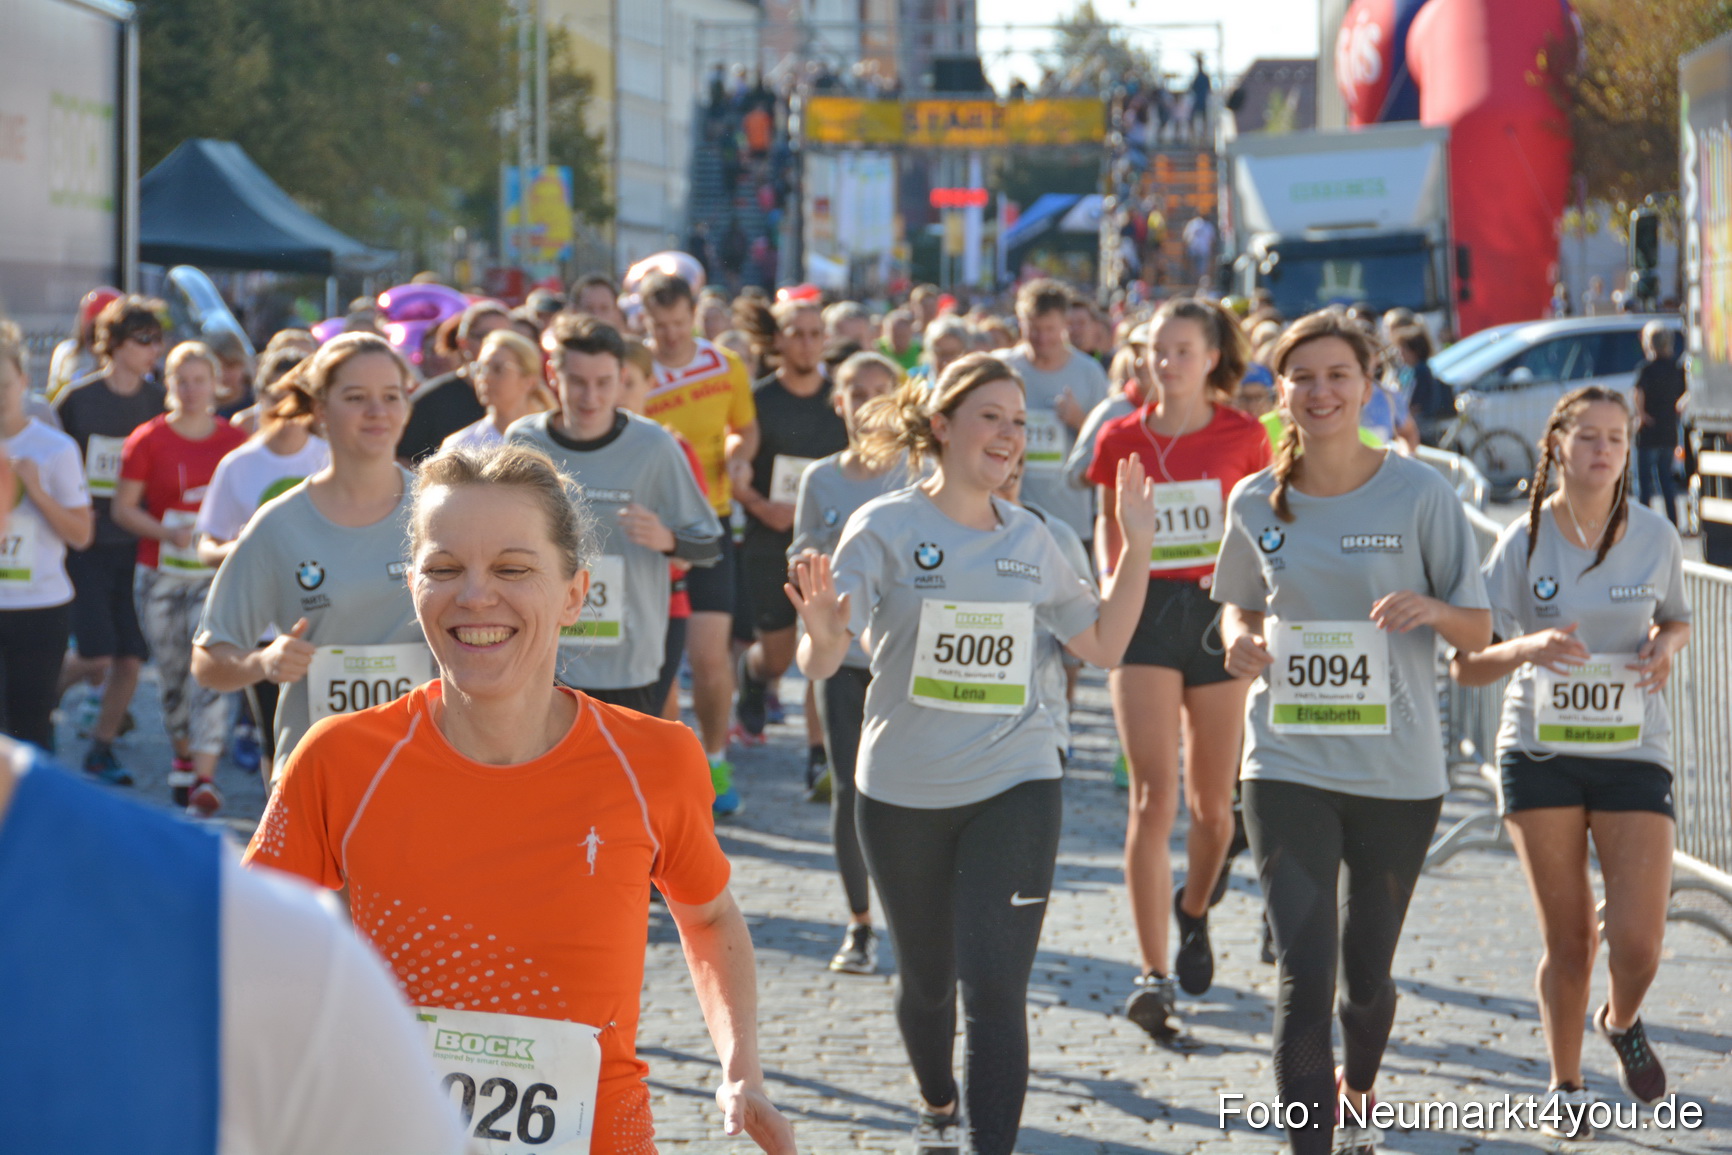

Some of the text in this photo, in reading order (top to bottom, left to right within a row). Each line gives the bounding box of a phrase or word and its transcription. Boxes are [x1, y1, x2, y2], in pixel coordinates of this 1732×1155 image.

[1341, 534, 1402, 550] BOCK
[996, 558, 1041, 580] BOCK
[955, 612, 1004, 626] BOCK
[1303, 631, 1355, 646] BOCK
[933, 633, 1014, 667] 5008
[1287, 654, 1371, 688] 5094
[953, 685, 987, 701] Lena
[1552, 683, 1625, 712] 5007
[1296, 706, 1361, 723] Elisabeth
[1564, 726, 1616, 742] Barbara
[434, 1028, 536, 1062] BOCK
[432, 1051, 535, 1070] inspired by smart concepts
